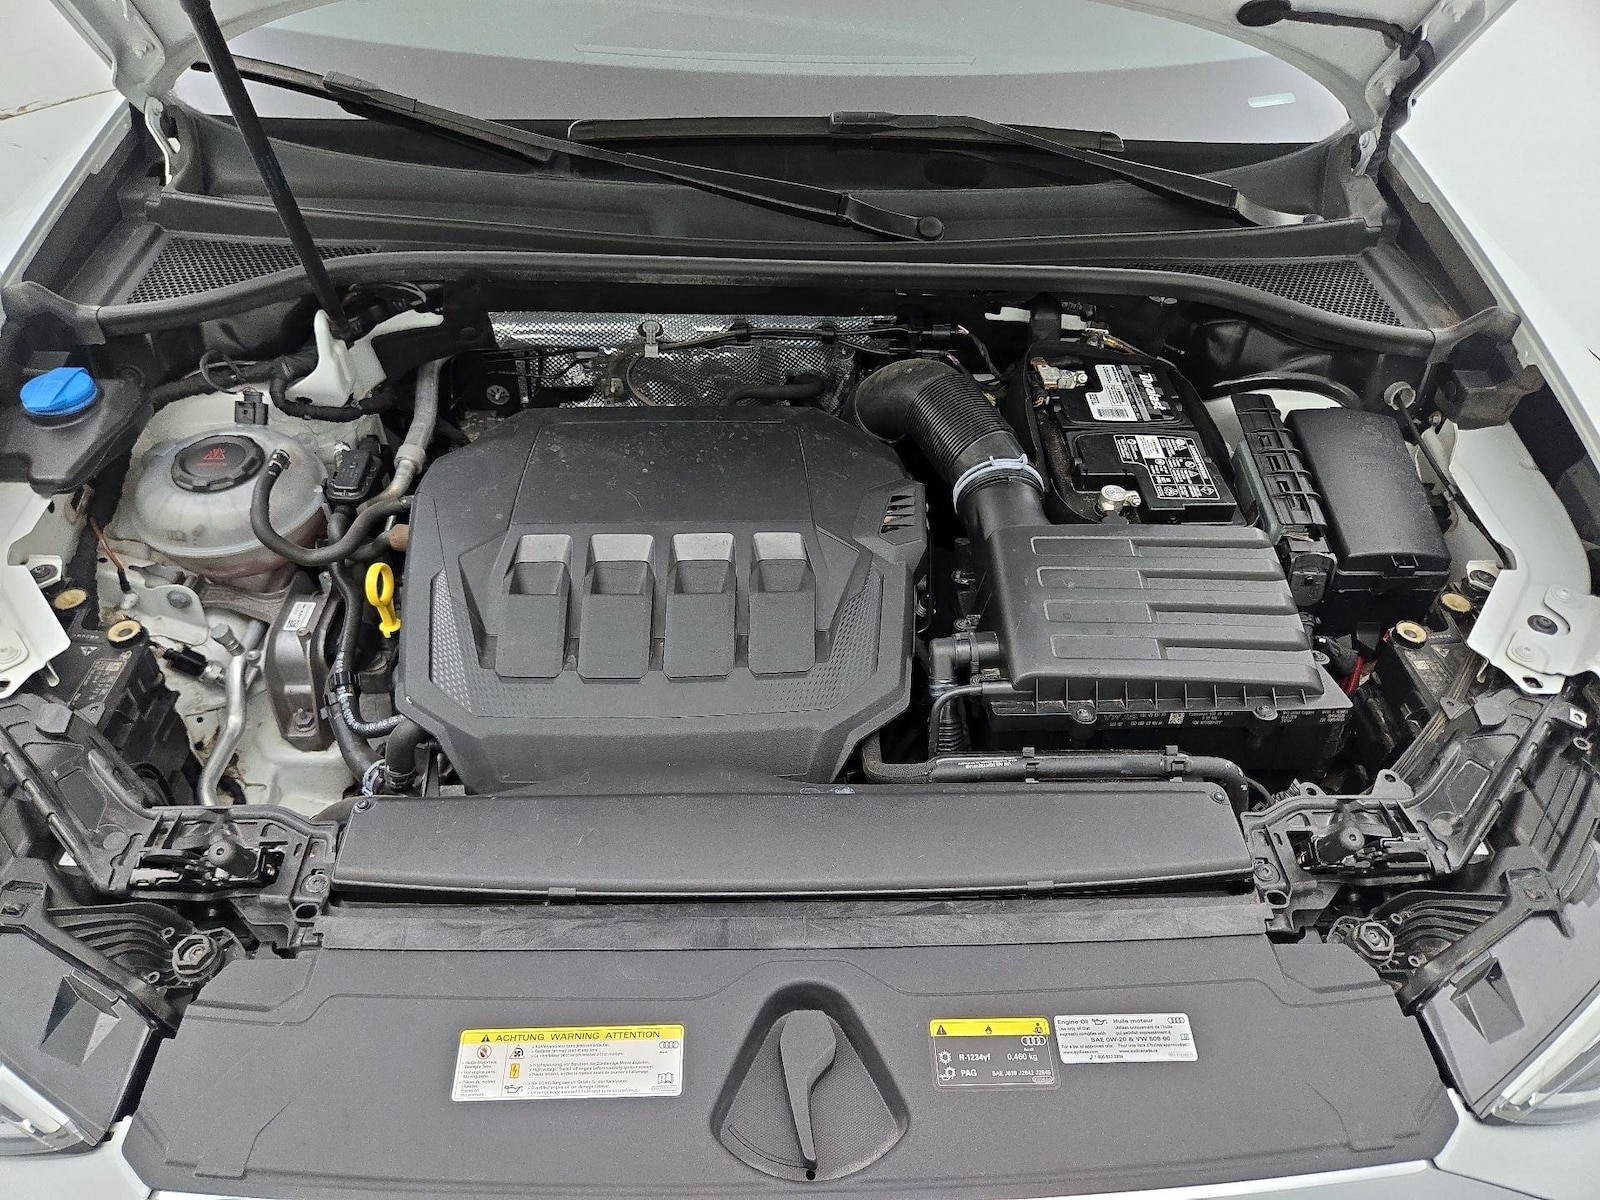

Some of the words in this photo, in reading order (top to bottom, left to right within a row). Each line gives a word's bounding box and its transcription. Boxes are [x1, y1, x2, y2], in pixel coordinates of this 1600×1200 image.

[1139, 372, 1167, 411] Duralast
[495, 1034, 544, 1042] ACHTUNG
[550, 1032, 600, 1040] WARNING
[605, 1031, 660, 1039] ATTENTION
[959, 1053, 991, 1062] R-1234yf
[1007, 1053, 1027, 1061] 0,460
[1029, 1053, 1038, 1061] kg
